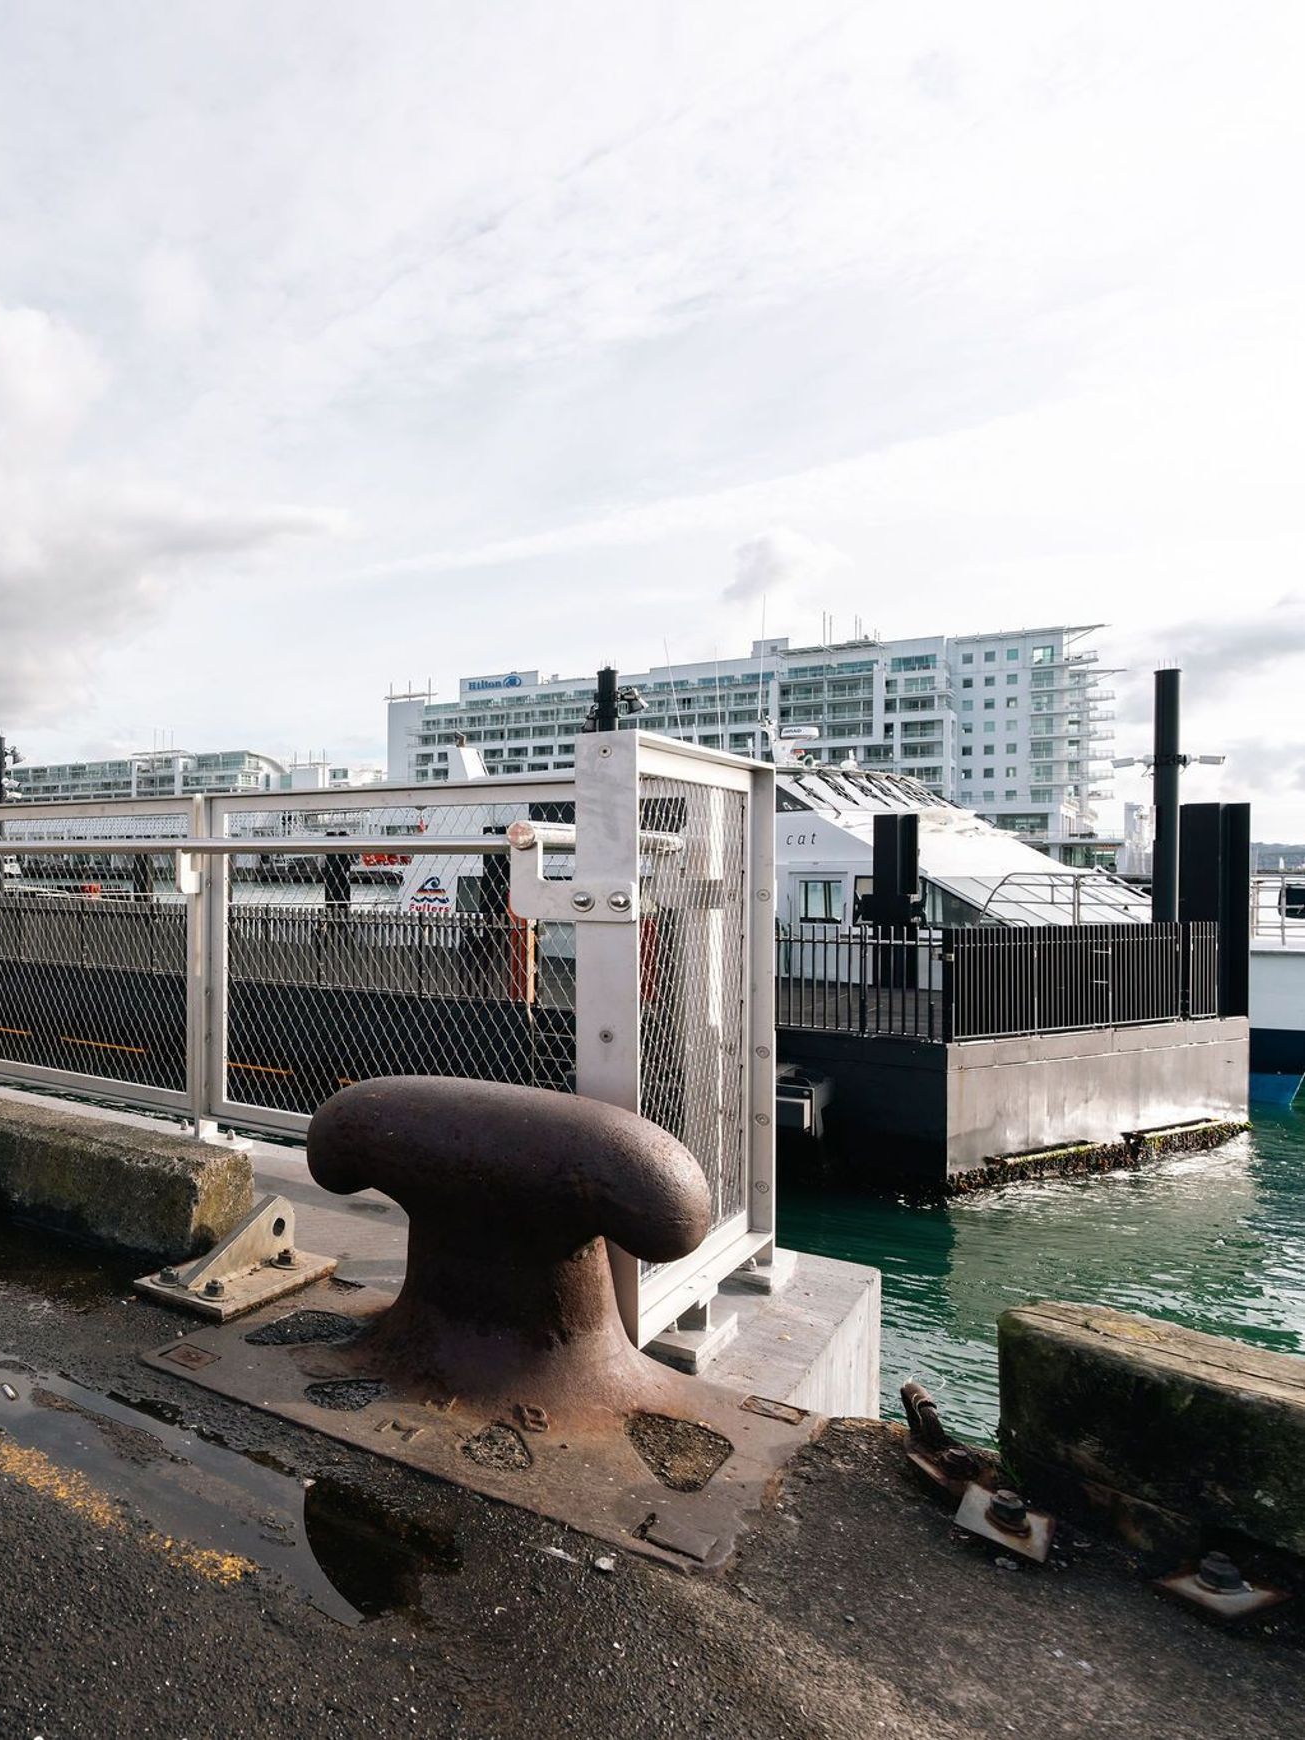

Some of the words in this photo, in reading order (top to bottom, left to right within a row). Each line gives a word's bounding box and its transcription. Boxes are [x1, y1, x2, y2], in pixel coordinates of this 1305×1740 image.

[468, 680, 502, 690] Hilton
[786, 833, 816, 846] cat
[409, 903, 450, 912] Fullers
